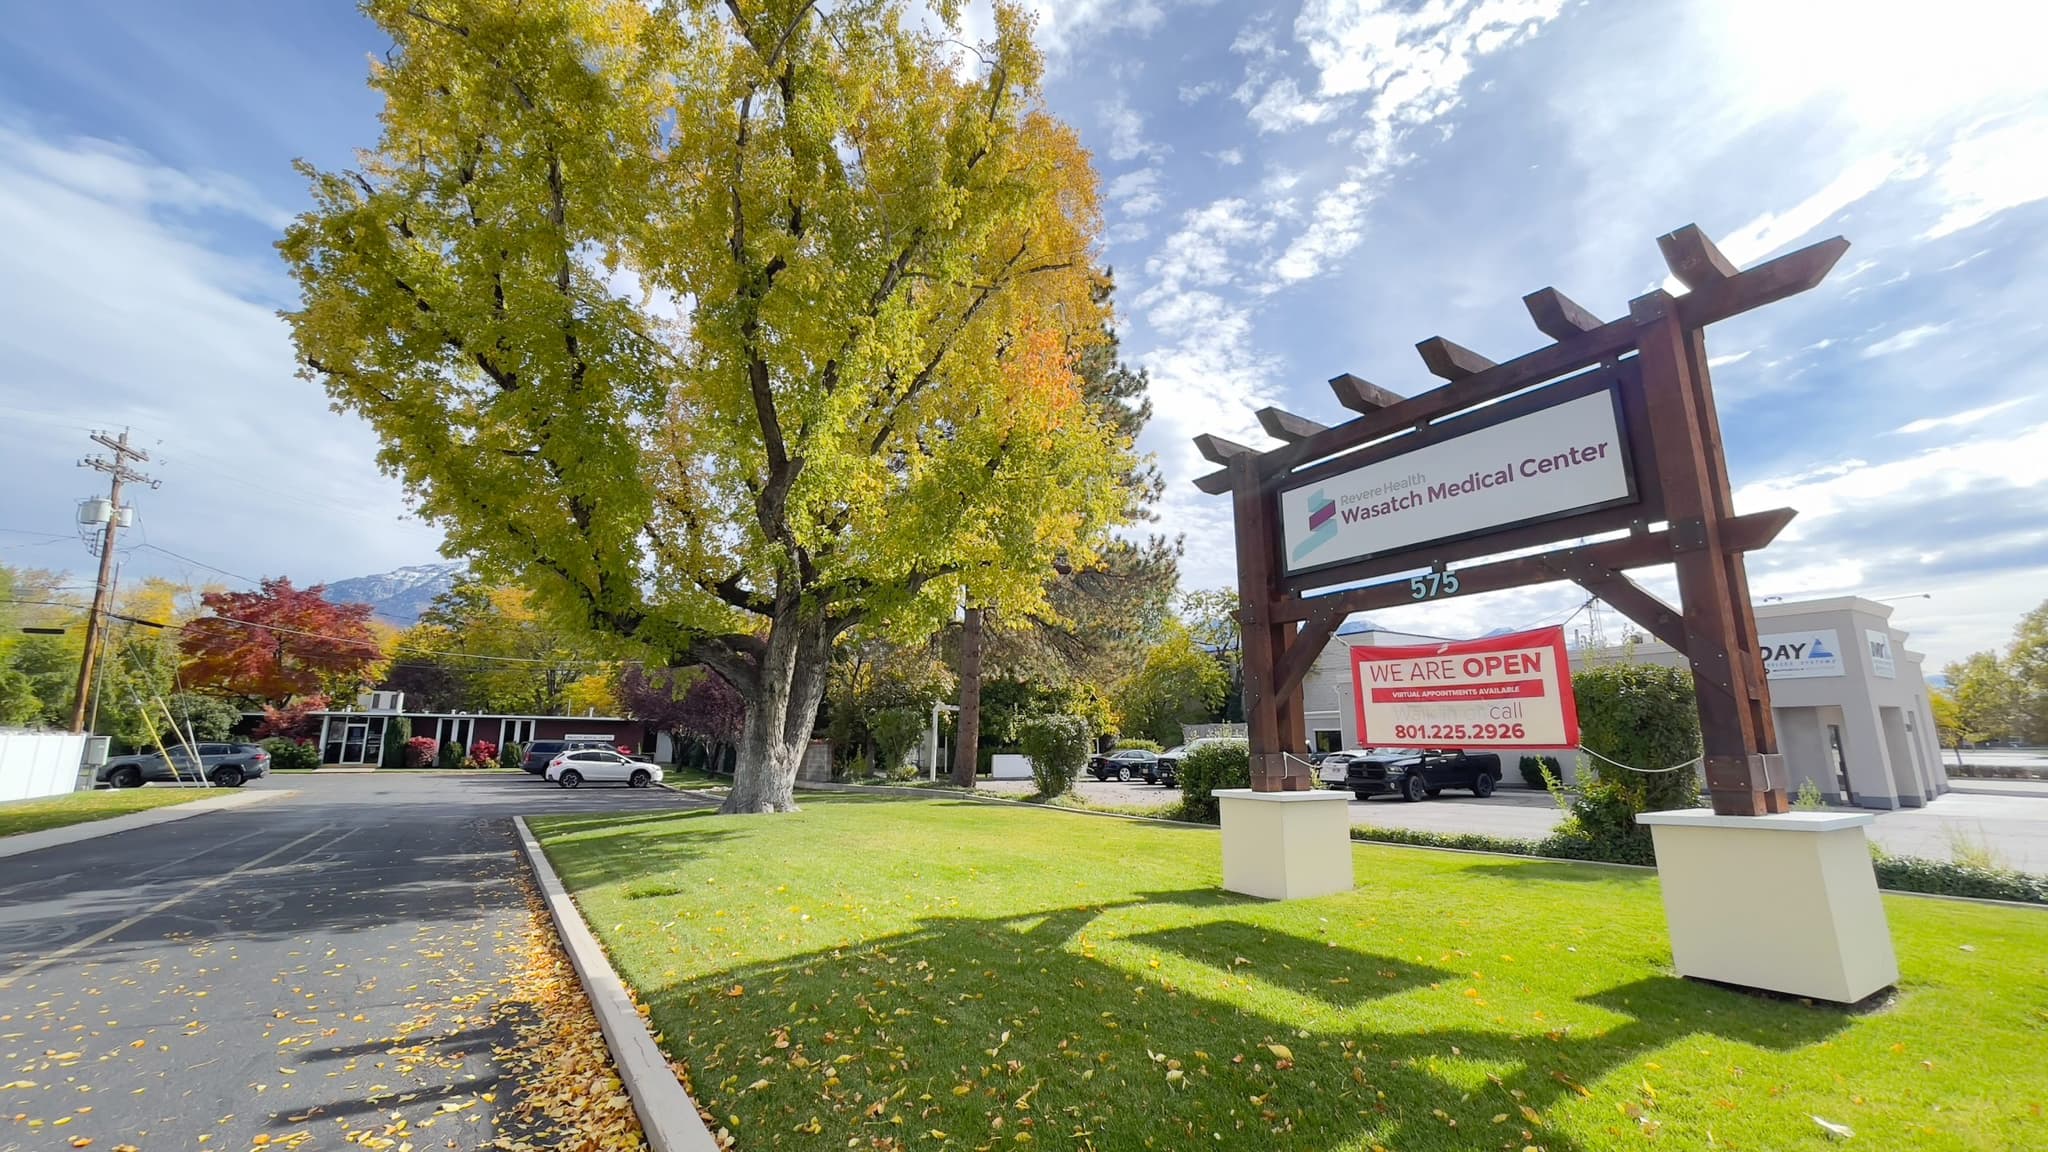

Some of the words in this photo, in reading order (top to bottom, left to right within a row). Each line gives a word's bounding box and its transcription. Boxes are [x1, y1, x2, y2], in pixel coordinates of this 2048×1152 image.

[1341, 491, 1423, 524] Wasatch
[1427, 463, 1514, 503] Medical
[1519, 441, 1608, 478] Center
[1341, 487, 1382, 506] Revere
[1384, 473, 1426, 494] Health
[1410, 570, 1459, 599] 575
[1369, 664, 1403, 682] WE
[1410, 659, 1456, 680] ARE
[1463, 652, 1541, 678] OPEN
[1392, 690, 1421, 698] VIRTUAL
[1421, 688, 1478, 697] APPOINTMENTS
[1478, 685, 1520, 695] AVAILABLE
[1489, 701, 1523, 720] call
[1394, 723, 1526, 740] 801.225.2926
